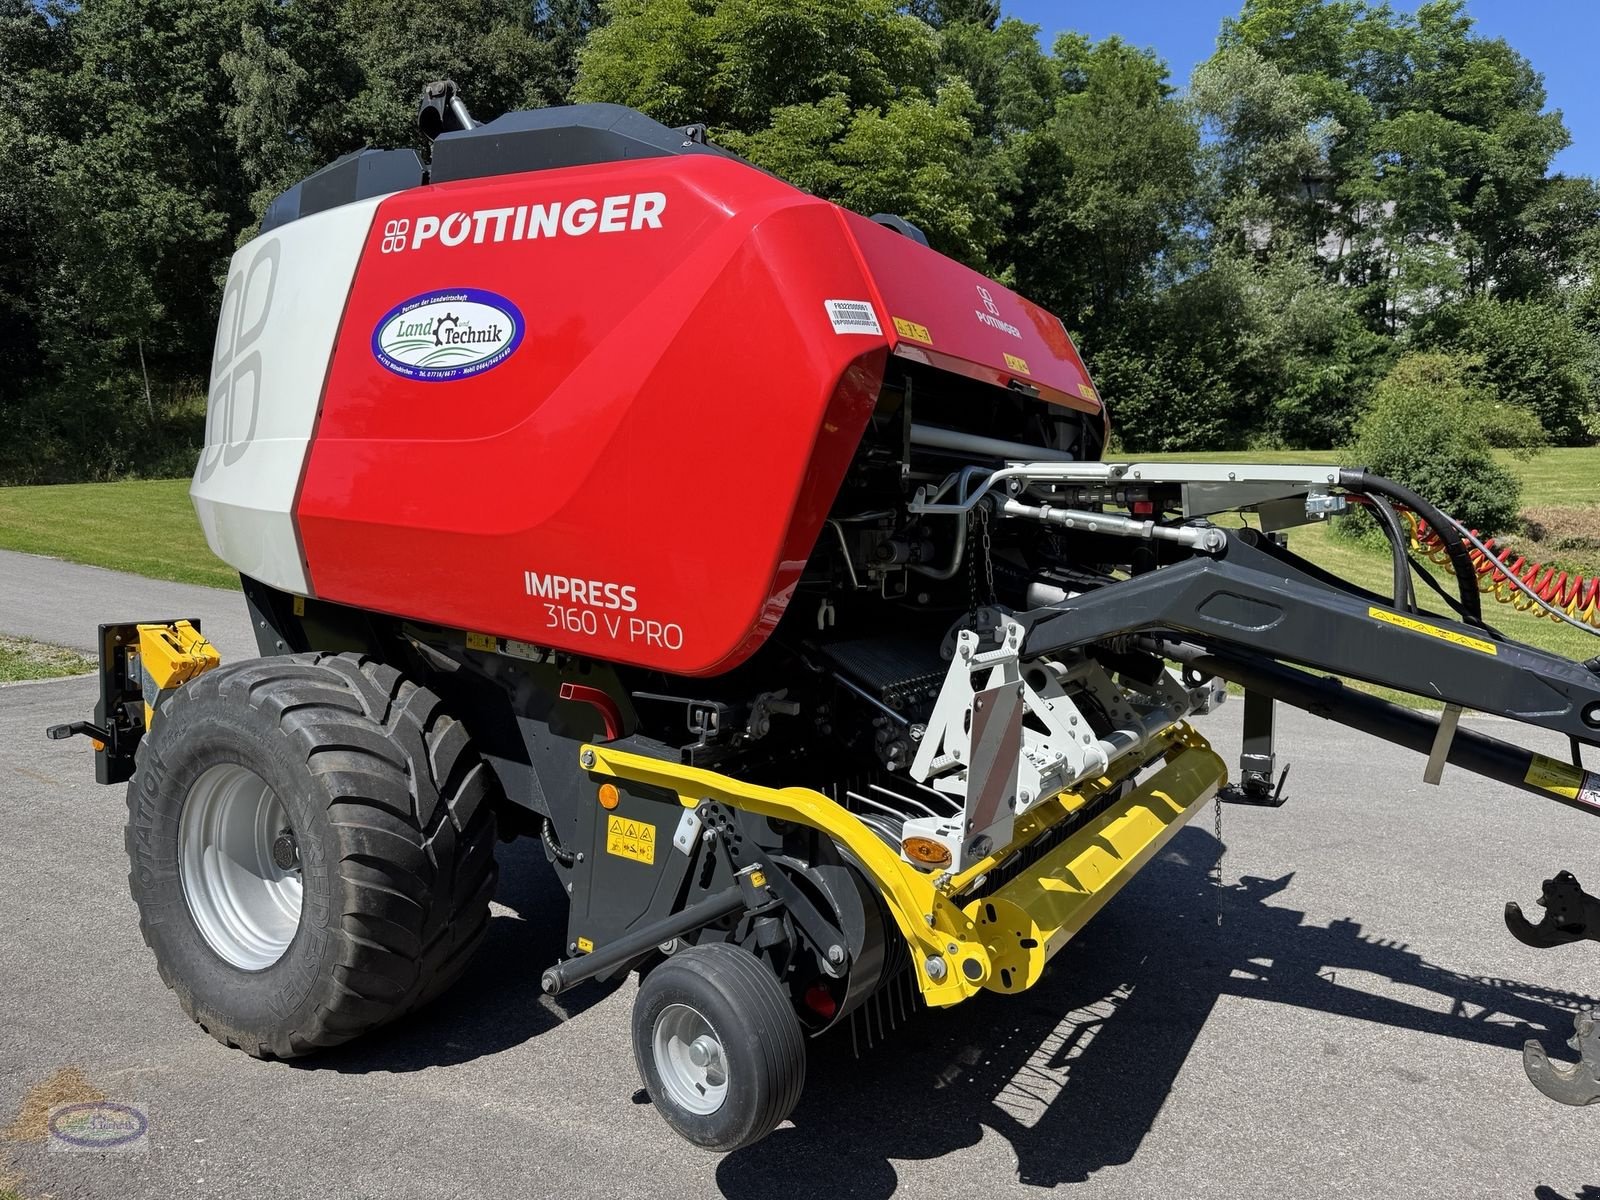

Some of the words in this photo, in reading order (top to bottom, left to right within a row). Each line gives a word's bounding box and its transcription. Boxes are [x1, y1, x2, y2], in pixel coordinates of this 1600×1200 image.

[411, 192, 667, 250] PÖTTINGER
[401, 303, 420, 313] Partner
[430, 294, 468, 304] Landwirtschaft
[396, 317, 434, 338] Land
[444, 324, 503, 345] Technik
[524, 570, 638, 612] IMPRESS
[543, 603, 598, 636] 3160
[603, 613, 621, 640] V
[629, 617, 683, 650] PRO
